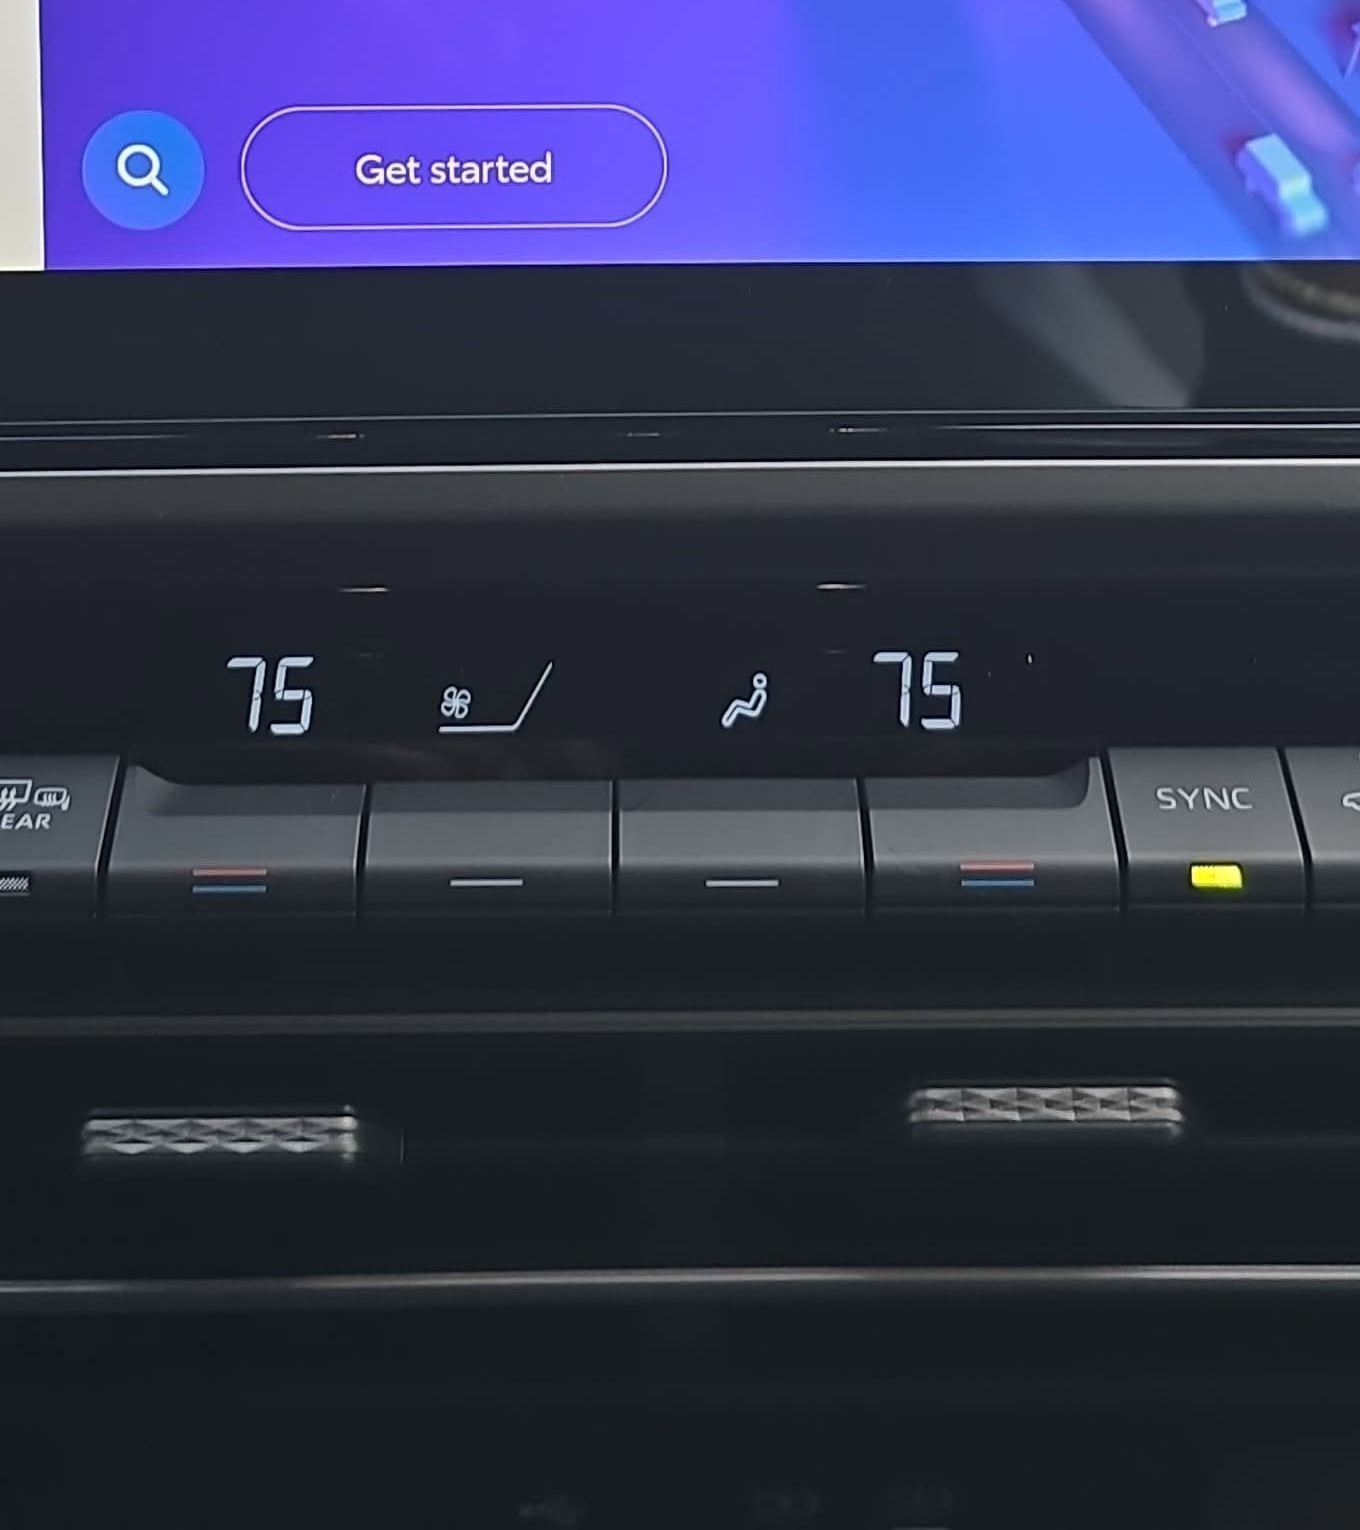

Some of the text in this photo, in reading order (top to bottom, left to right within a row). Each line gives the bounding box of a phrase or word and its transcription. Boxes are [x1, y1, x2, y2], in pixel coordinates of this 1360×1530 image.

[355, 150, 553, 185] Get started
[226, 656, 315, 736] 75
[873, 651, 962, 731] 75
[1156, 786, 1254, 812] SYNC
